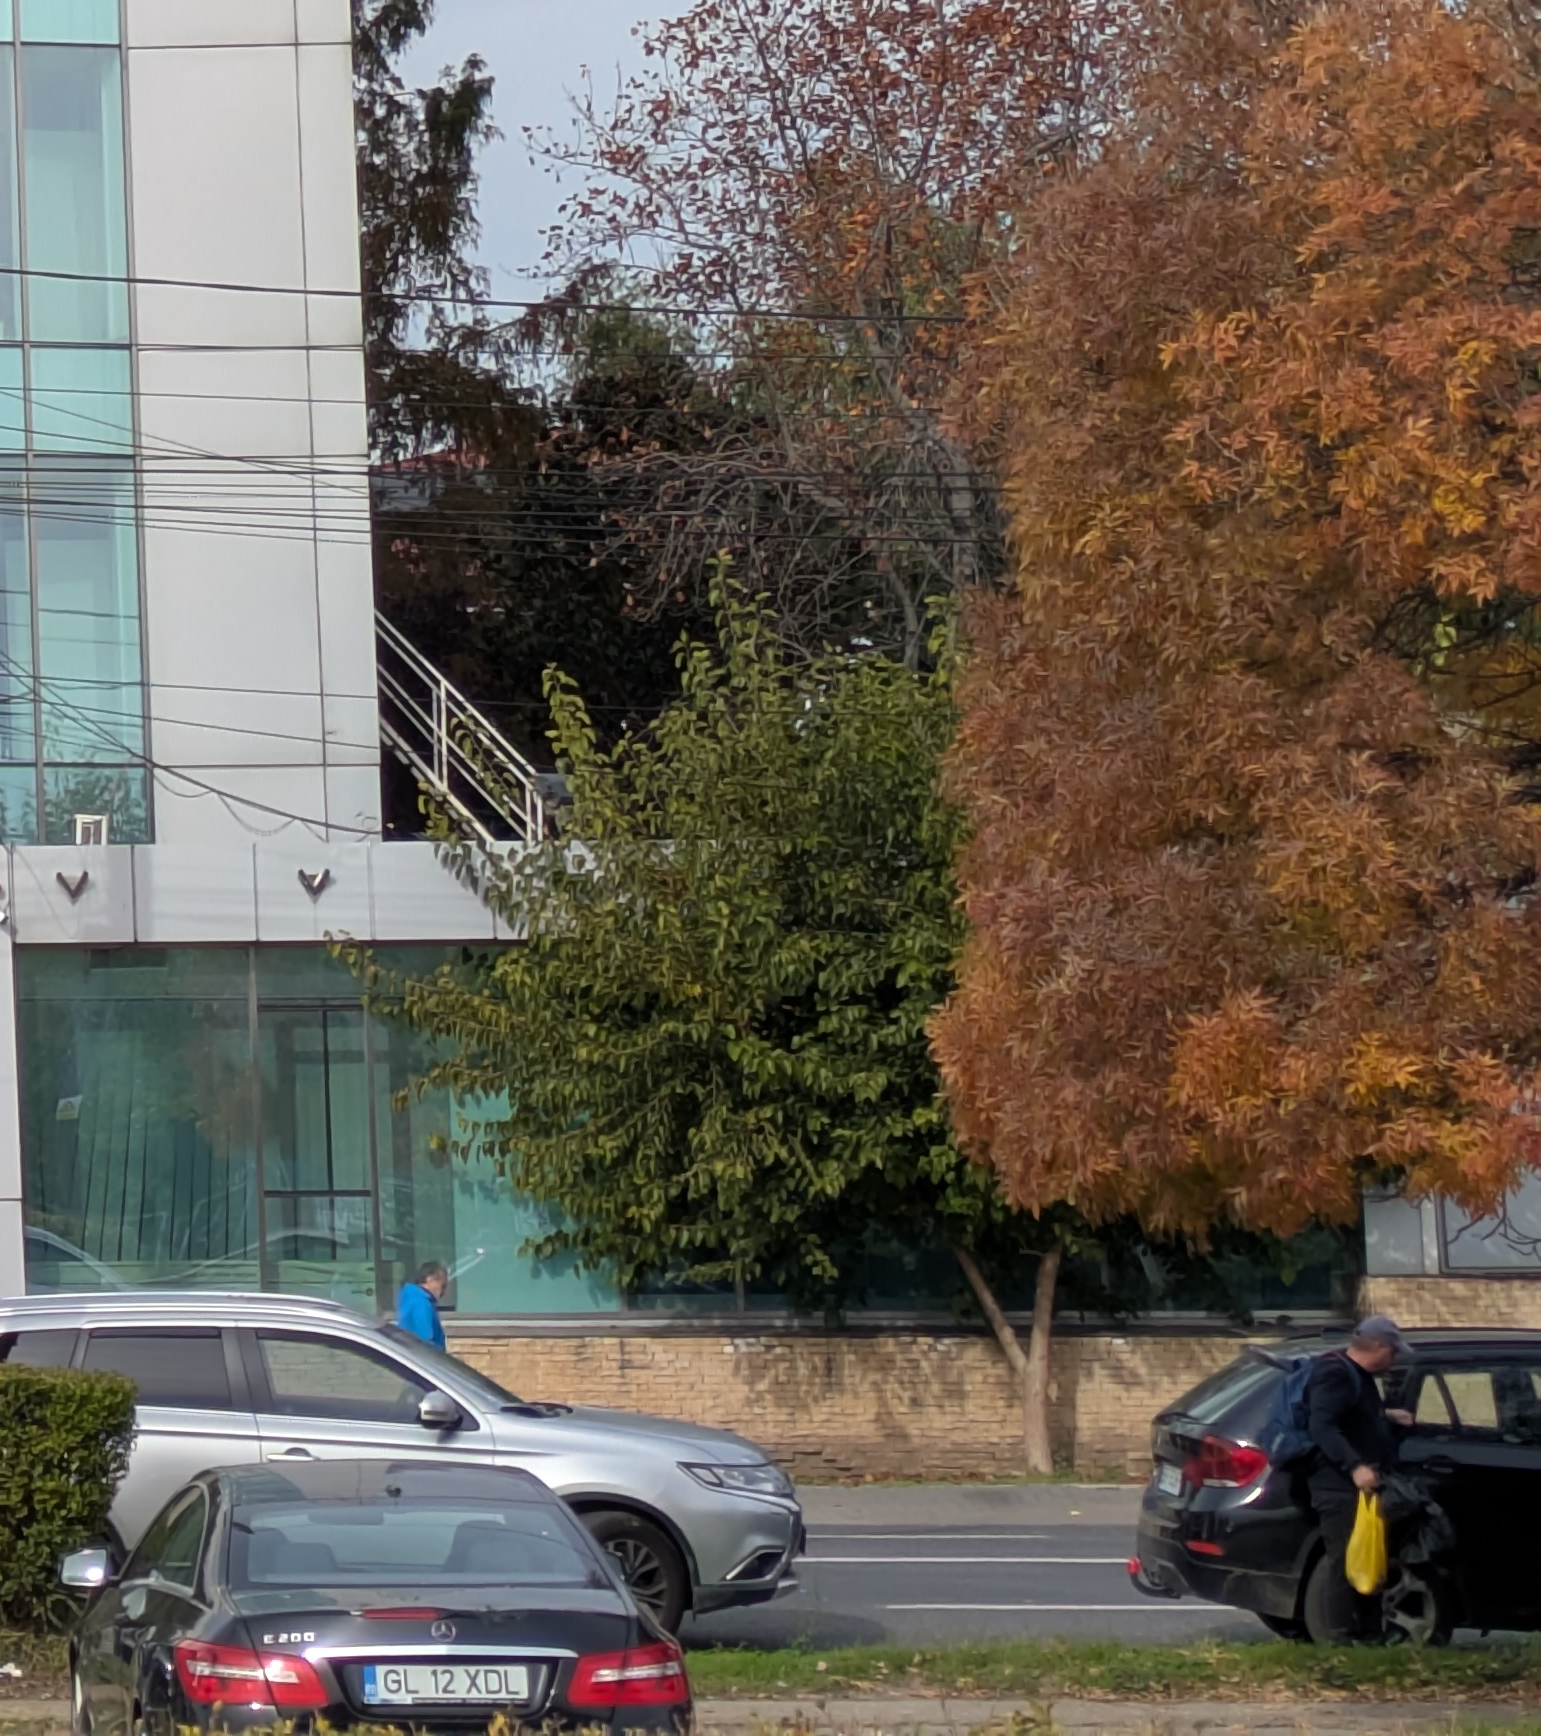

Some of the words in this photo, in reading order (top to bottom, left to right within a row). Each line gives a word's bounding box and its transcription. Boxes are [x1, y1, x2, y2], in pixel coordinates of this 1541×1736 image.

[383, 1668, 419, 1694] GL
[430, 1668, 456, 1695] 12
[464, 1668, 521, 1695] XDL
